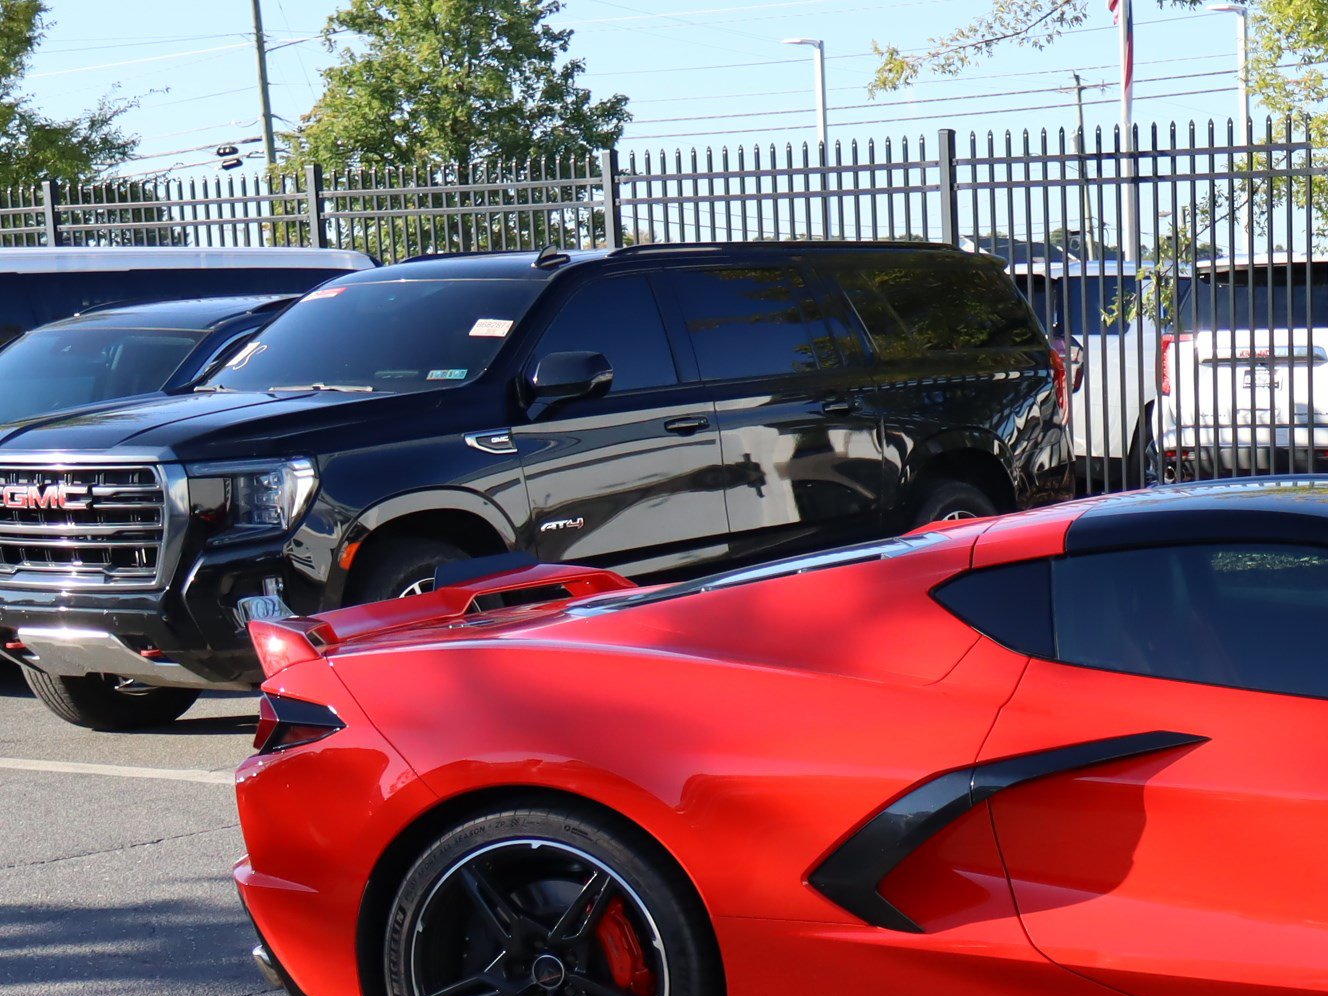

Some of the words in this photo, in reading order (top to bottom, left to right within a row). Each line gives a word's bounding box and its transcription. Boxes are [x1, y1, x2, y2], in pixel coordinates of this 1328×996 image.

[490, 435, 509, 443] GMC
[3, 484, 88, 509] GMC
[540, 517, 584, 532] AT4
[389, 907, 405, 996] MICHELIN
